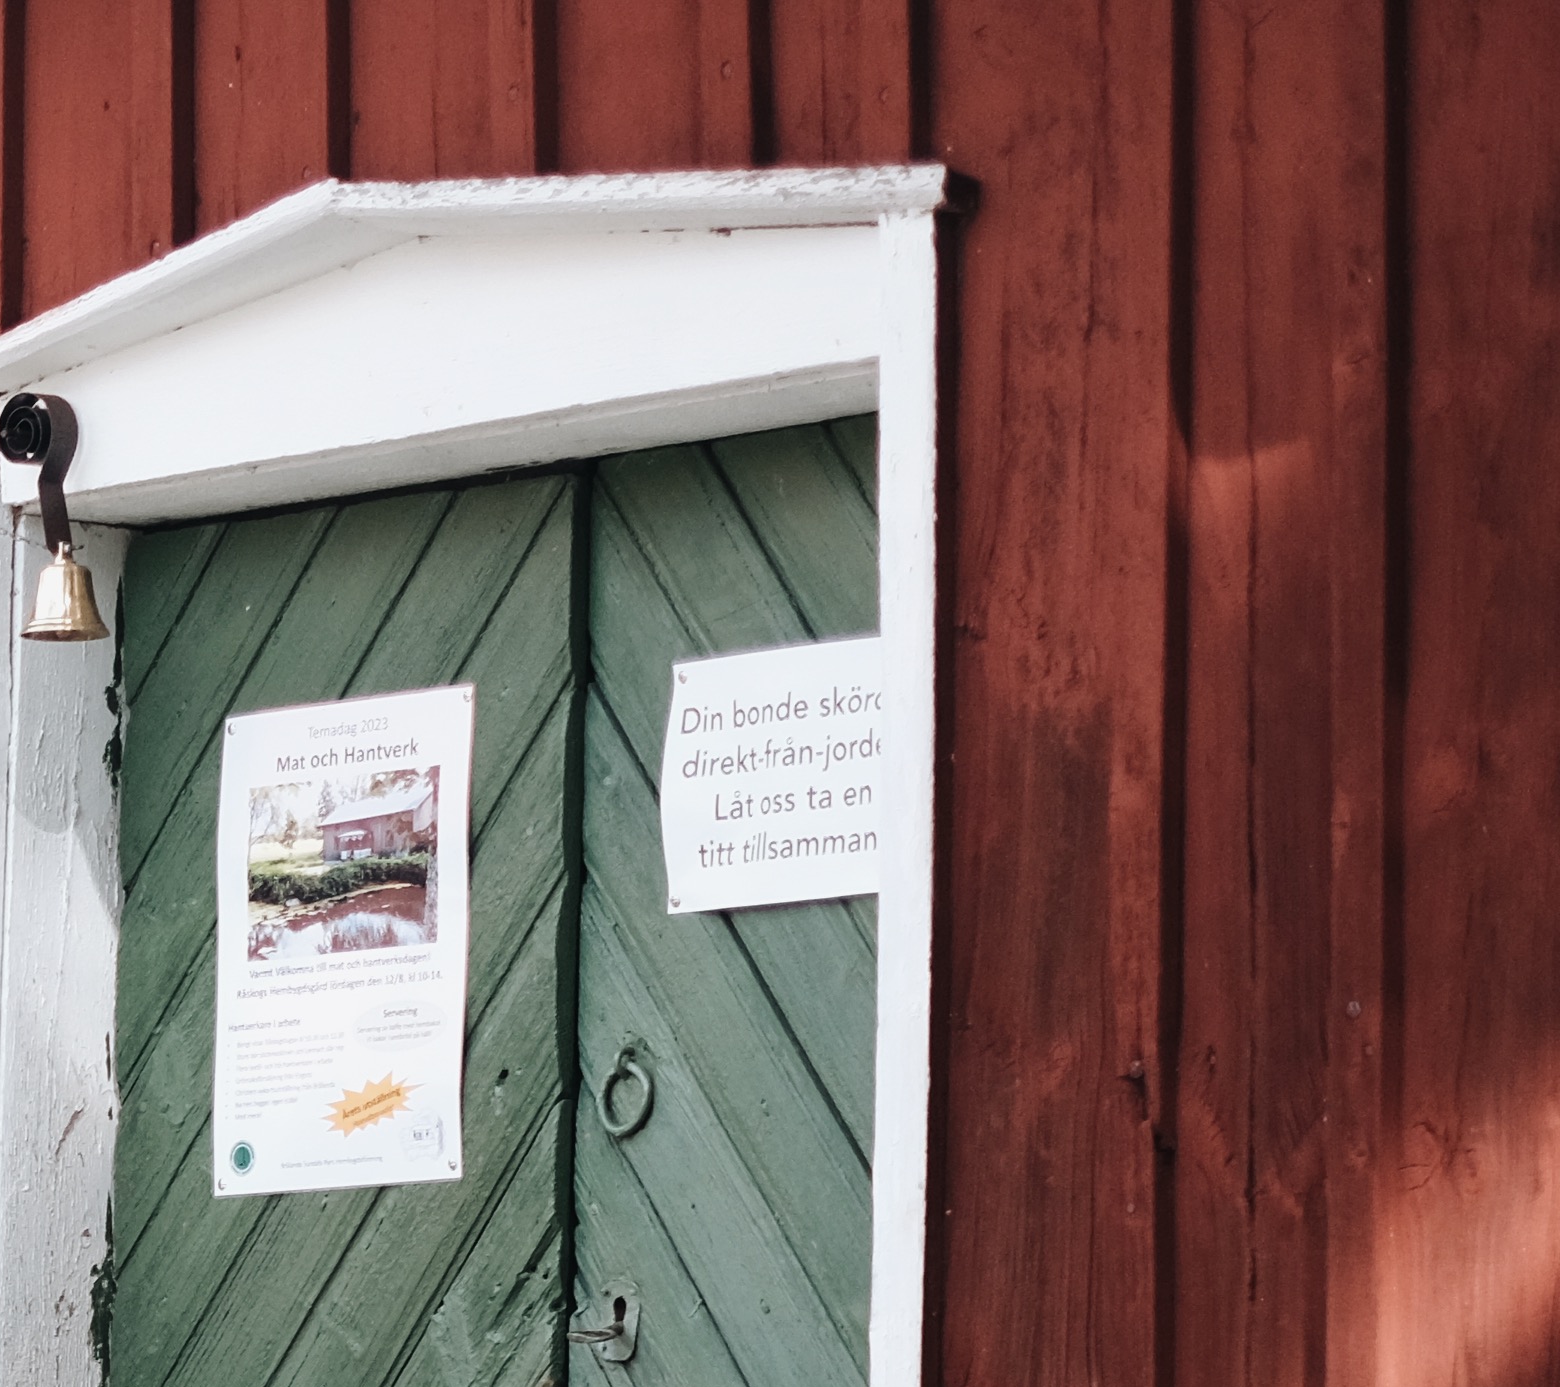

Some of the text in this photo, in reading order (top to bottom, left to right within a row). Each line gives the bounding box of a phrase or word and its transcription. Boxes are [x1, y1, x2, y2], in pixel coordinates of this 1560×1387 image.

[680, 707, 724, 735] Din
[732, 691, 809, 729] bonde
[307, 716, 389, 740] Temadag 2023
[275, 737, 419, 772] Mat och Hantverk
[714, 784, 872, 821] Låt oss ta en
[698, 840, 734, 869] titt
[346, 959, 361, 969] och
[367, 977, 383, 986] den
